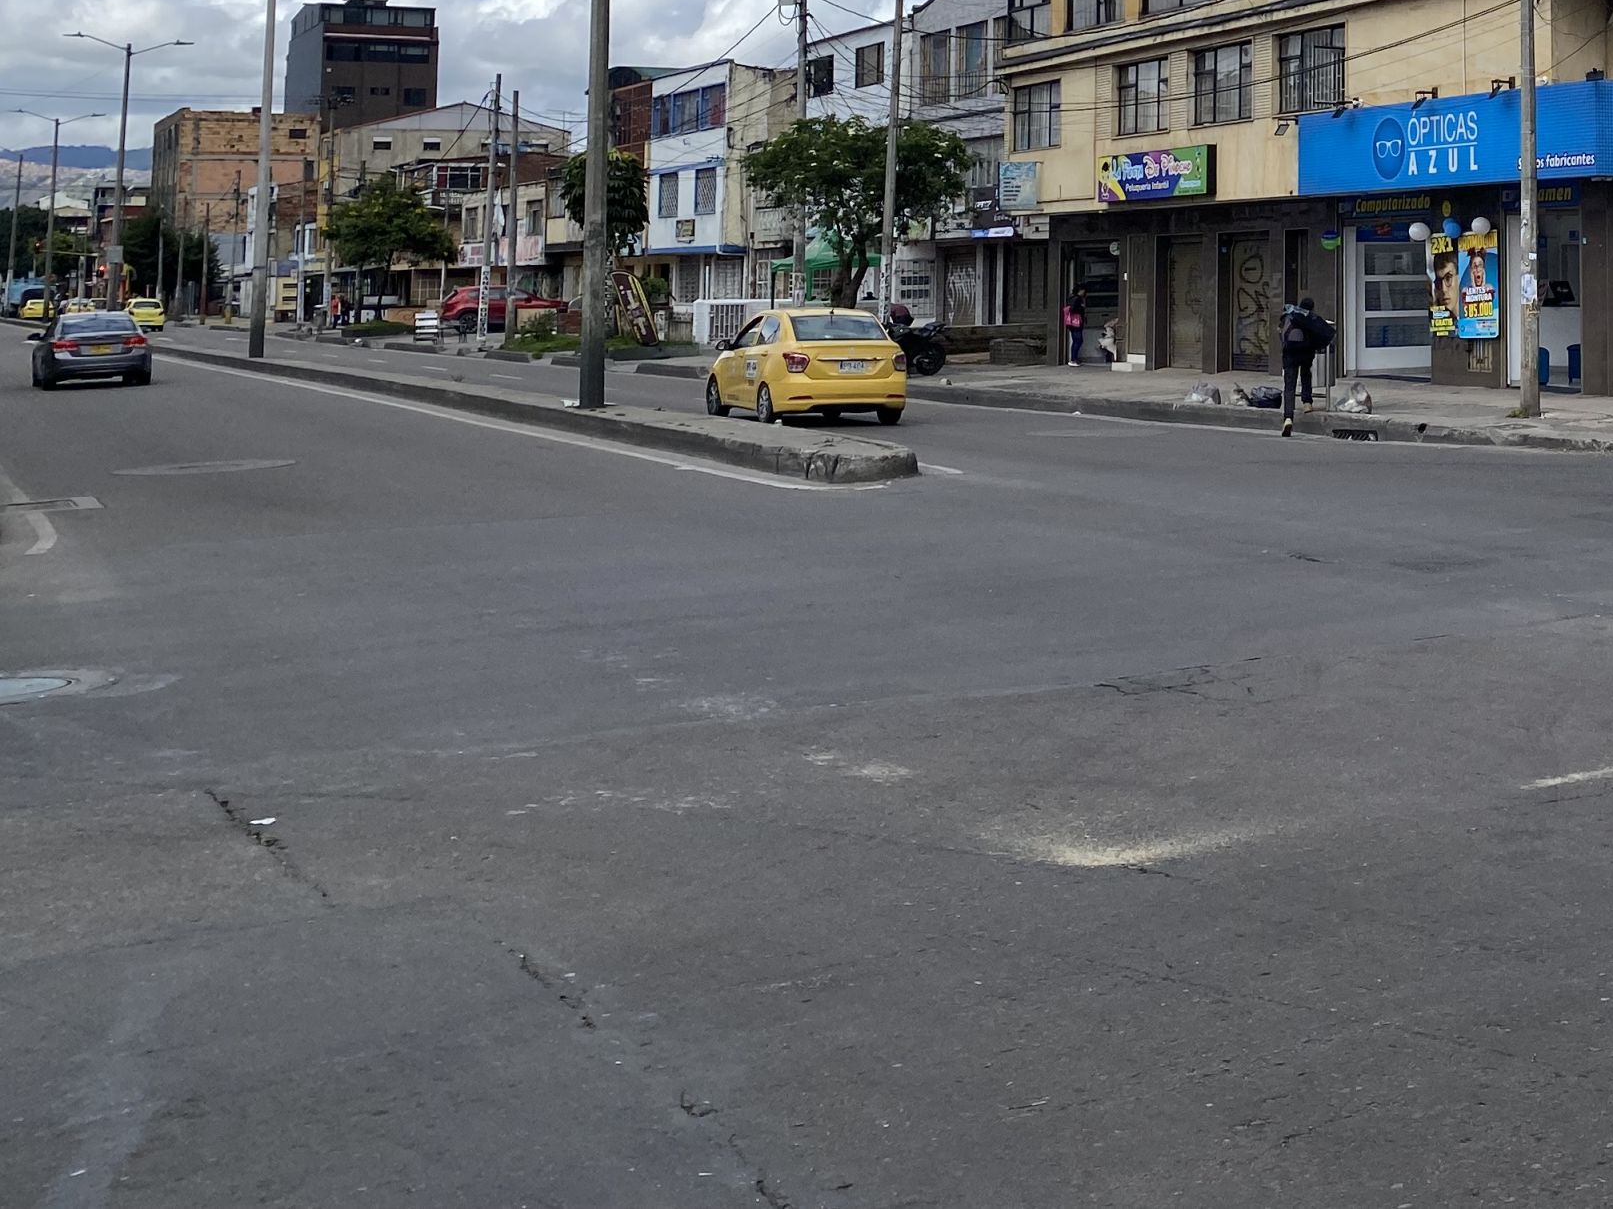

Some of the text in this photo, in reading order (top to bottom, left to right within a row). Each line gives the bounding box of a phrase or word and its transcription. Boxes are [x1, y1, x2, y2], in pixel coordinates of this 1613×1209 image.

[1407, 109, 1478, 146] ÓPTICAS
[1408, 146, 1479, 177] AZUL
[1517, 153, 1595, 171] Sos fabricantes
[1355, 193, 1431, 214] Computarizado
[1537, 186, 1572, 202] amen
[1431, 236, 1454, 255] 2X1
